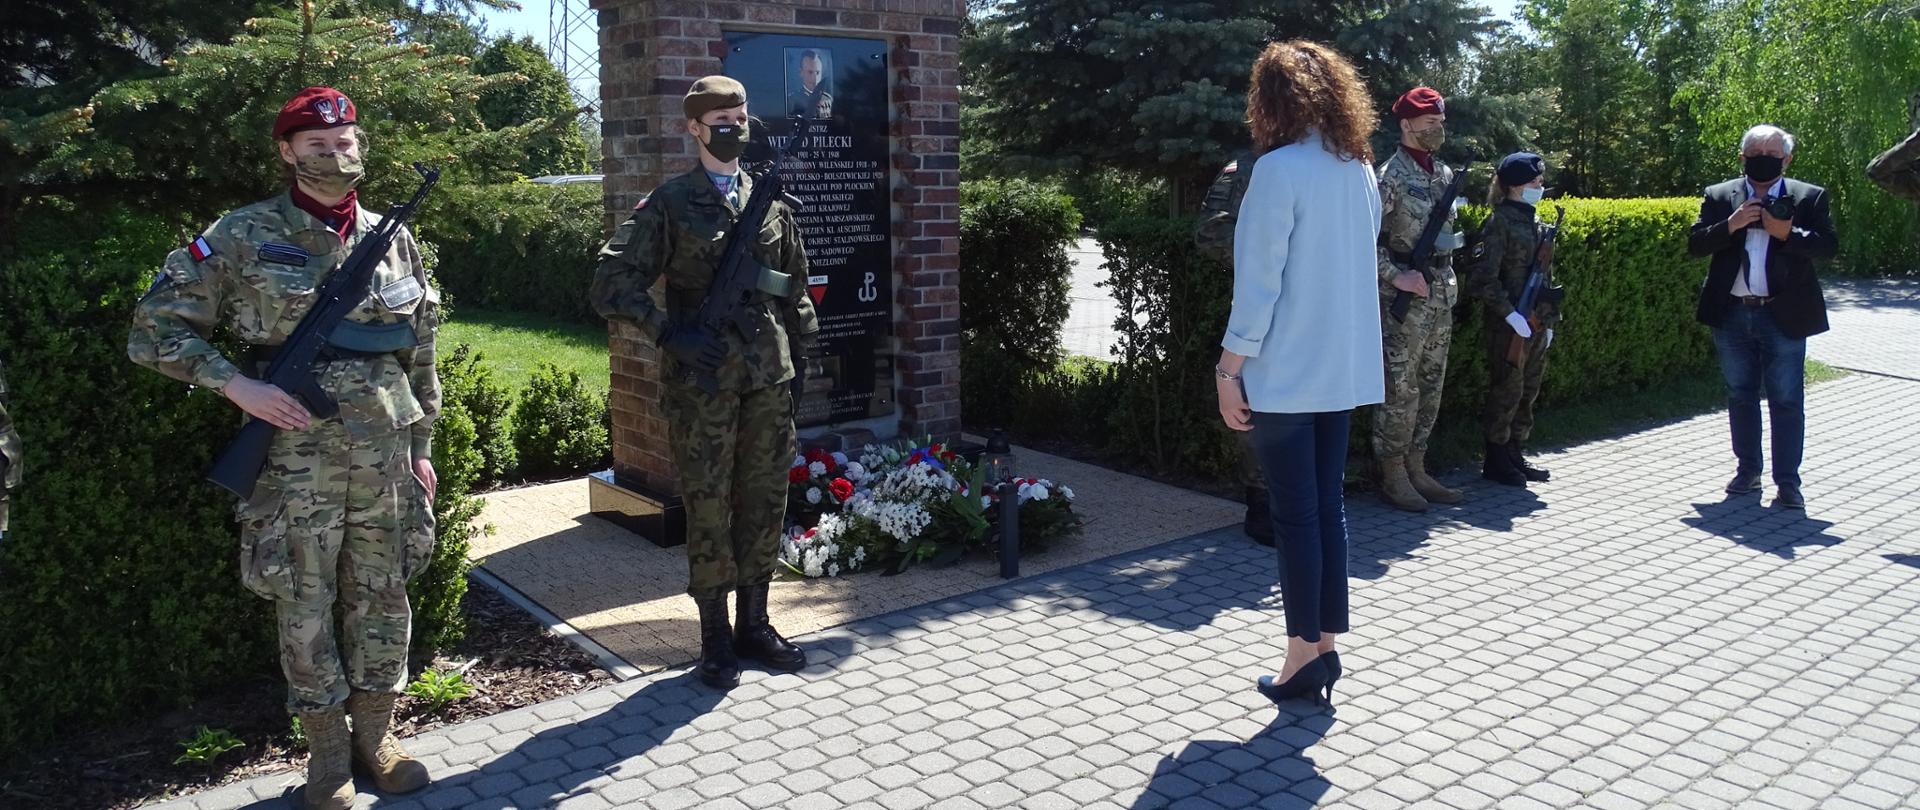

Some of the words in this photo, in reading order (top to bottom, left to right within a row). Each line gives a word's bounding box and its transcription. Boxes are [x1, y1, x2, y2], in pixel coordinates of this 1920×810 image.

[768, 136, 808, 148] WITD
[813, 135, 852, 148] PILECKI
[780, 161, 816, 170] AMOOBRONY
[820, 193, 854, 201] POLSKIEGO
[818, 204, 851, 212] KRAJOWEJ
[825, 213, 875, 223] WARSZAWSKIEGO
[837, 224, 871, 233] AUSCHWITZ
[807, 237, 832, 246] OKRESU
[833, 234, 884, 244] STALINOWSKIEGO
